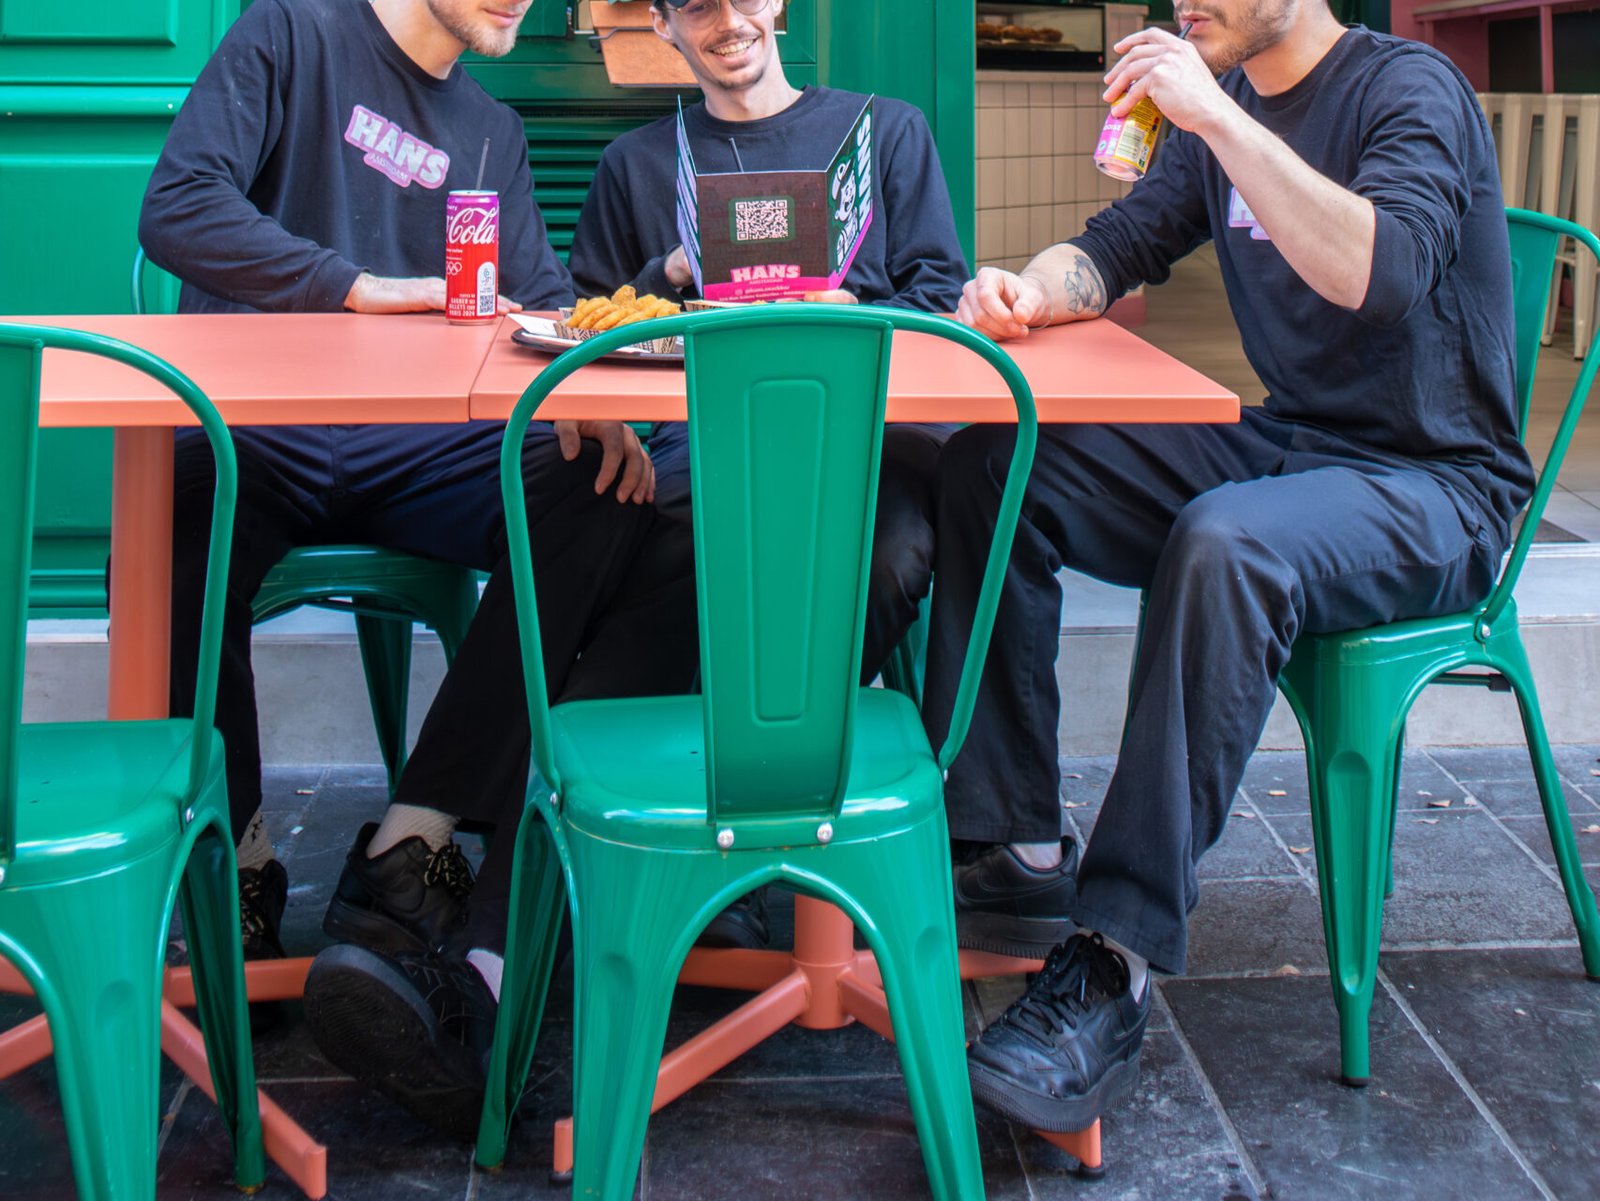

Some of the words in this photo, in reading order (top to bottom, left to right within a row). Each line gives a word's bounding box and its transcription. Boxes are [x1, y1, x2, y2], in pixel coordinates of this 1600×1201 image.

[350, 110, 446, 183] HANS
[856, 113, 871, 231] HANS
[732, 265, 799, 282] HANS
